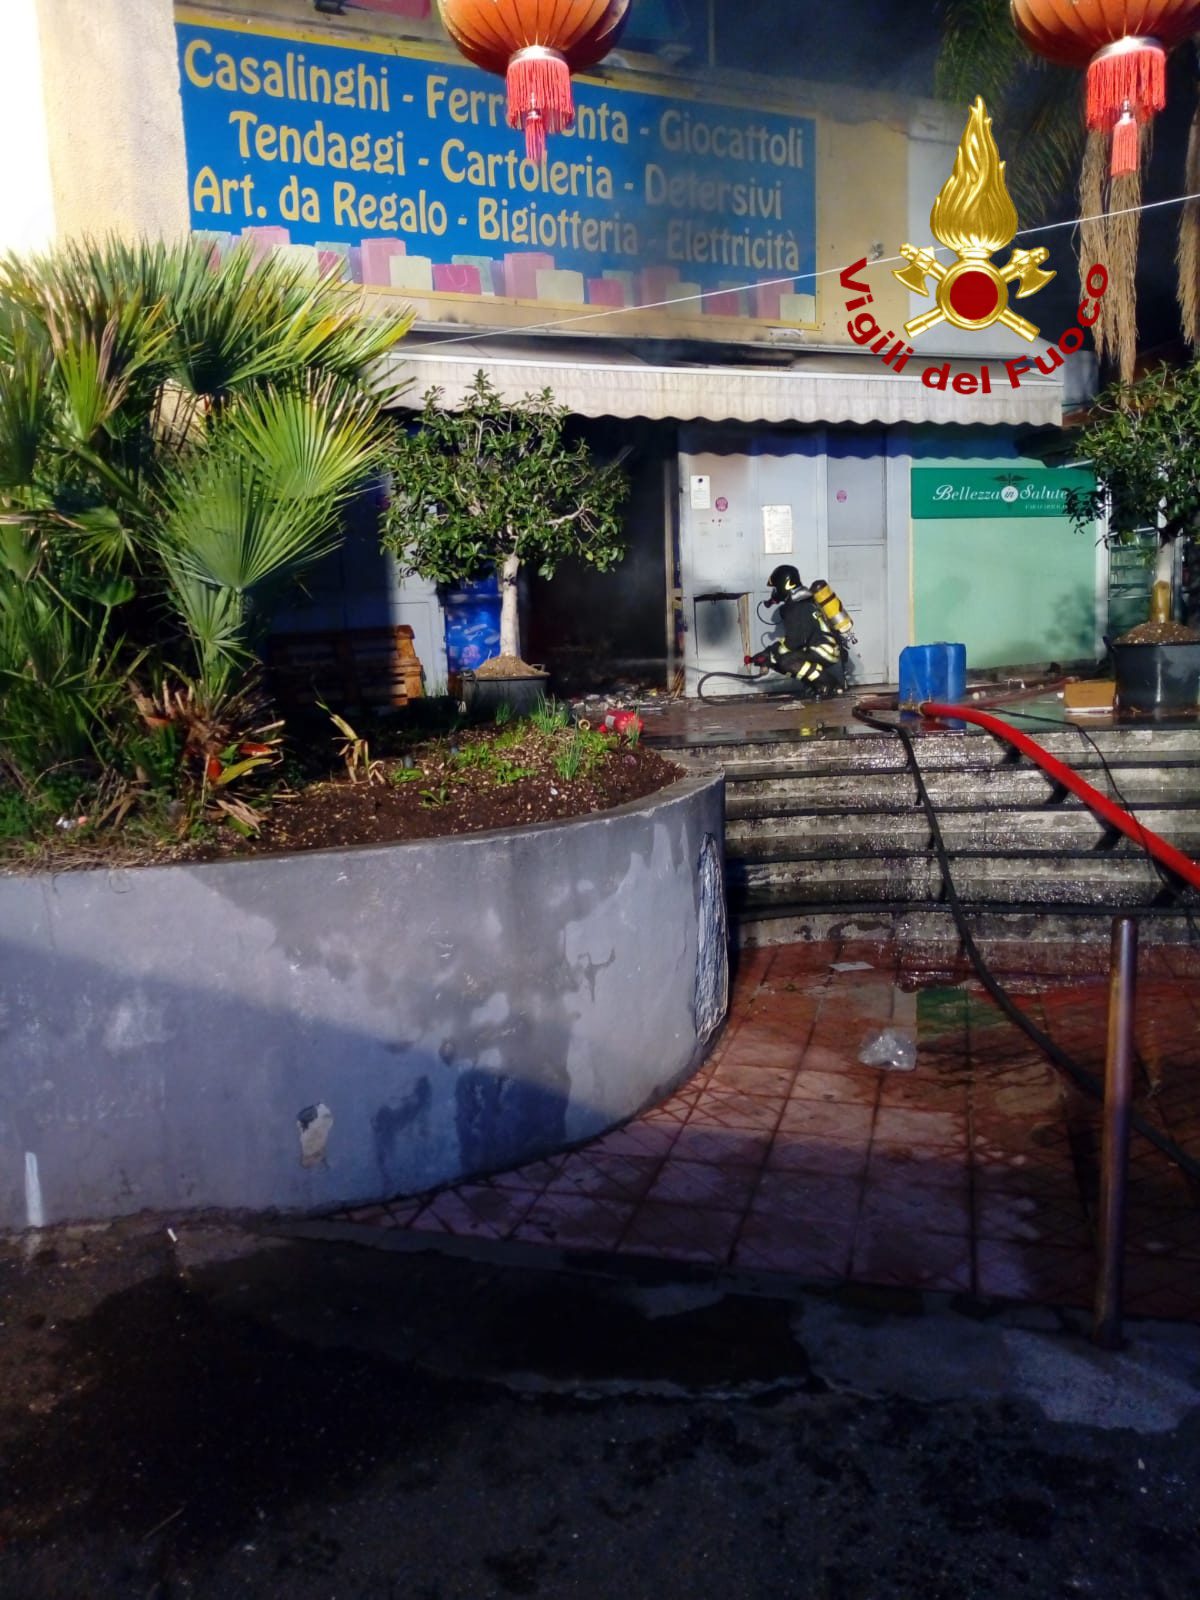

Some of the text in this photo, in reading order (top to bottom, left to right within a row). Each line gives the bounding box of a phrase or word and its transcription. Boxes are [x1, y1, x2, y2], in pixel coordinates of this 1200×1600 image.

[184, 40, 390, 112] Casalinghi
[426, 75, 629, 144] Ferrnta
[660, 109, 803, 168] Giocattoli
[194, 166, 268, 218] Art.
[279, 175, 320, 223] da
[333, 181, 447, 236] Regalo
[478, 197, 638, 255] Bigiotteria
[668, 218, 799, 271] Elettricità
[229, 110, 405, 176] Tendaggi
[441, 138, 614, 200] Cartoleria
[645, 163, 782, 220] Detersivi
[932, 484, 1000, 500] Bellezza
[1019, 483, 1068, 500] Salute
